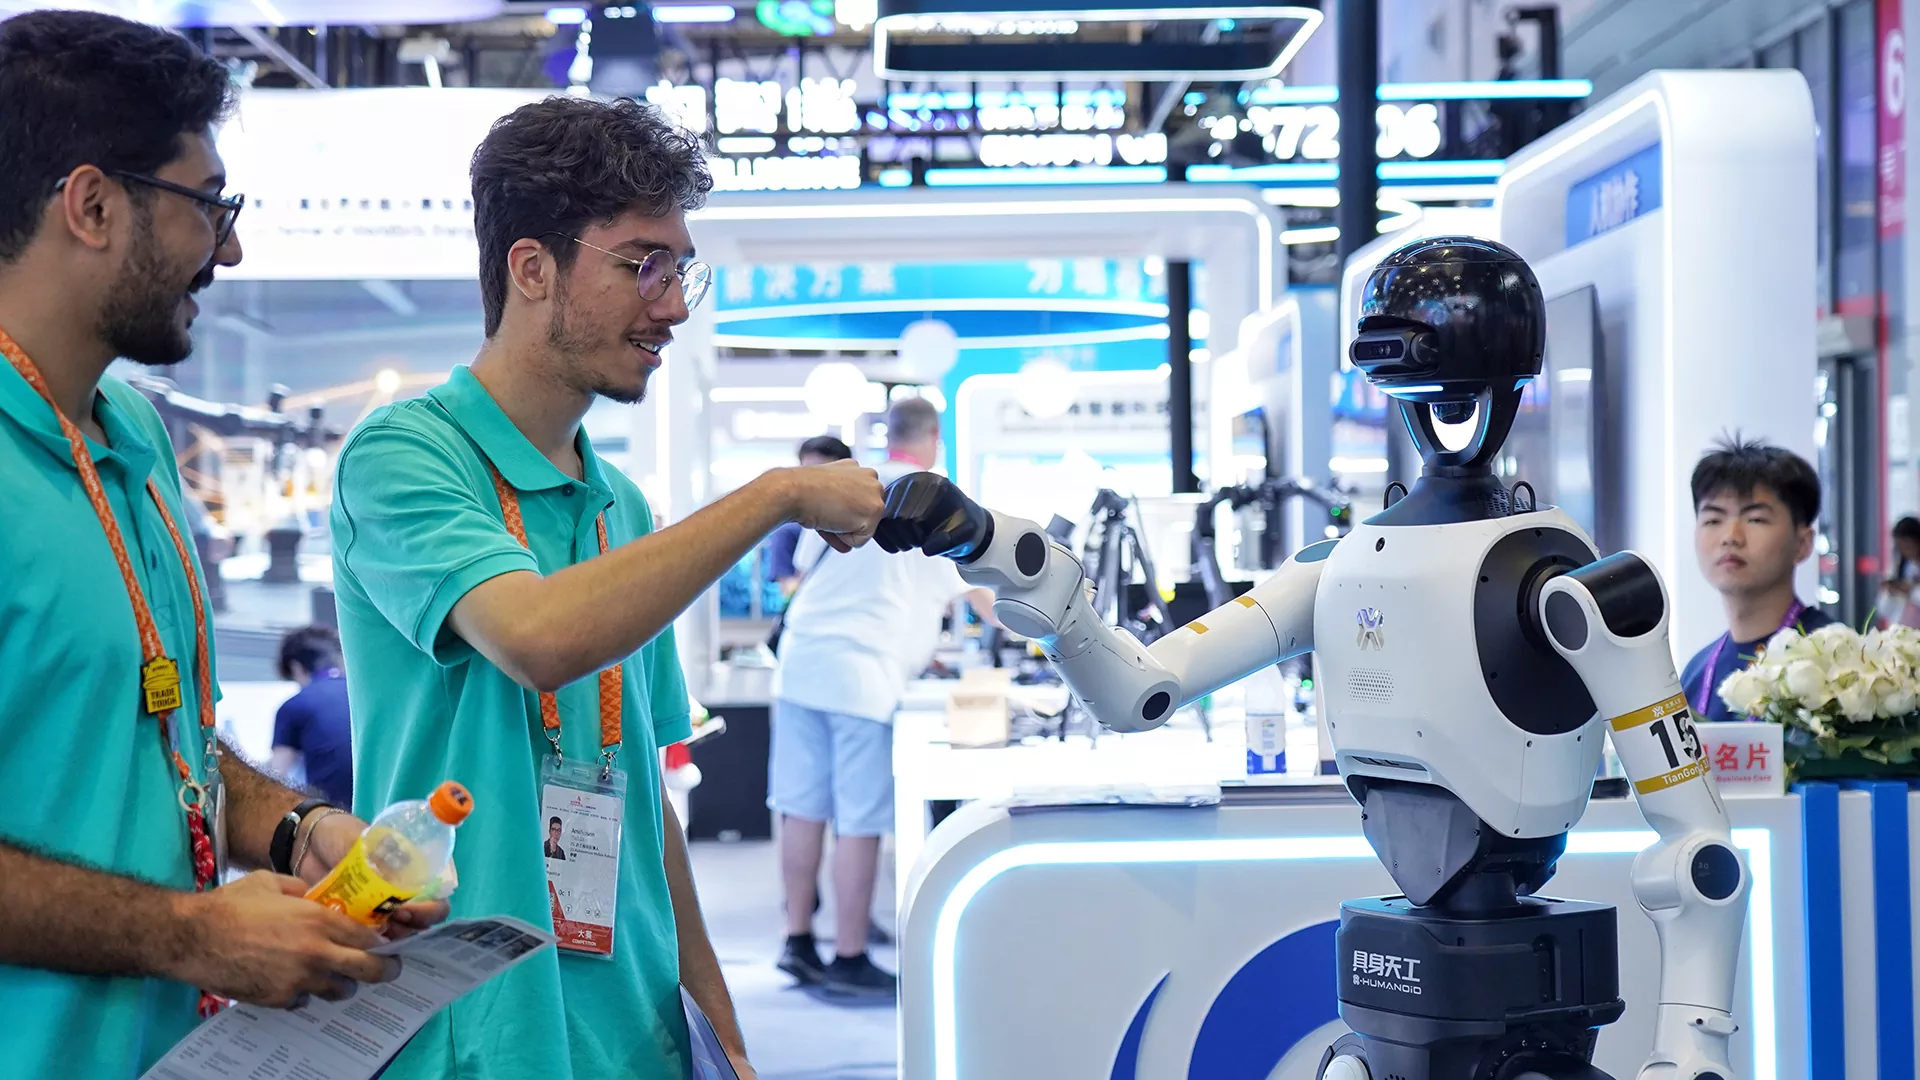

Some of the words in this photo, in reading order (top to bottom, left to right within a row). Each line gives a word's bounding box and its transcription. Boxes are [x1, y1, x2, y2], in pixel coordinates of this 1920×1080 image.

[1649, 709, 1702, 769] 15
[1702, 743, 1770, 770] 名片
[1353, 950, 1421, 982] 具身天工
